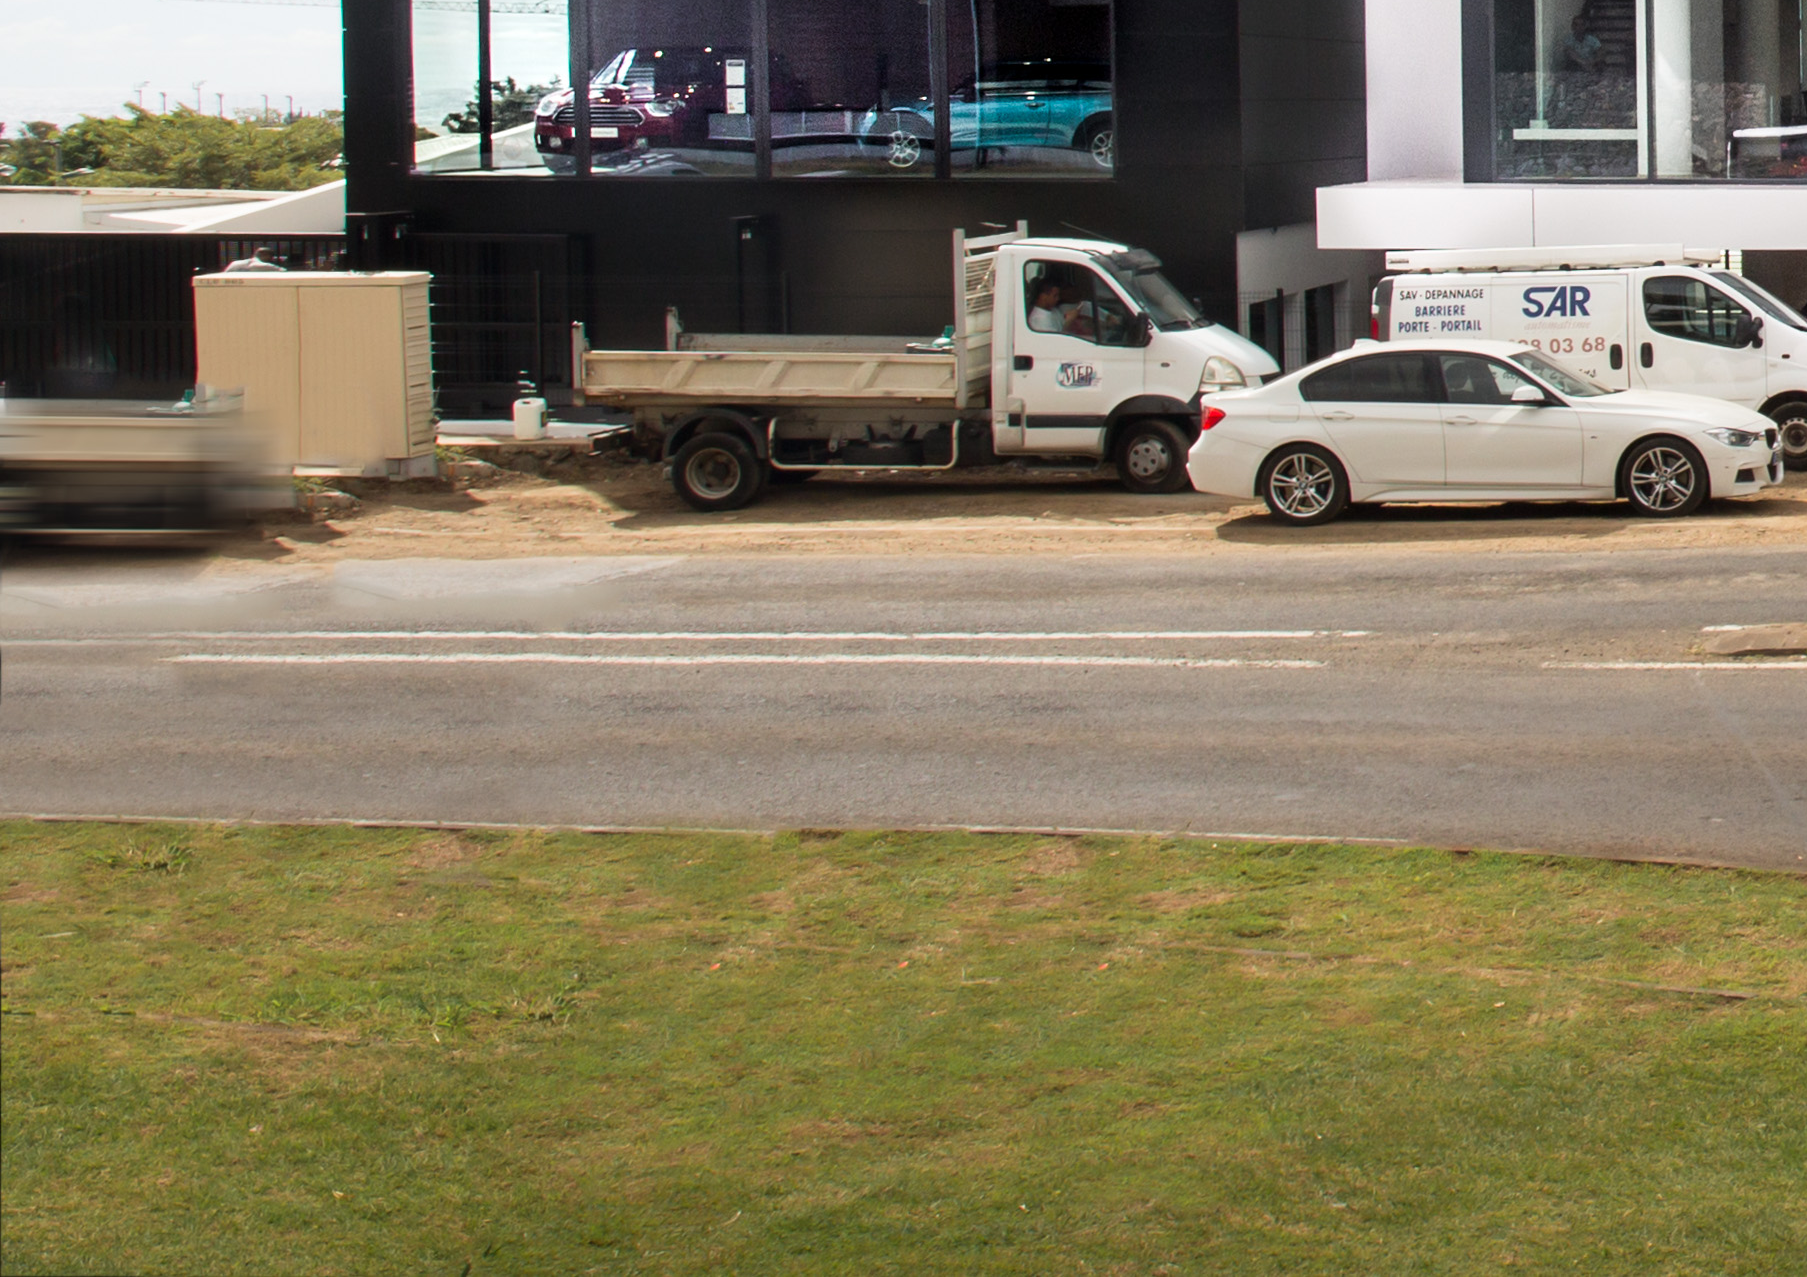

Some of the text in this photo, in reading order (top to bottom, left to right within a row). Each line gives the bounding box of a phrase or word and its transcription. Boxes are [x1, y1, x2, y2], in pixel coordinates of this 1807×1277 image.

[1399, 290, 1418, 300] SAV
[1425, 288, 1485, 300] DEPANNAGE
[1522, 285, 1591, 318] SAR
[1415, 305, 1466, 317] BARRIERE
[1398, 321, 1430, 333] PORTE
[1441, 320, 1482, 332] PORTAIL
[1549, 337, 1574, 354] 03
[1581, 336, 1606, 353] 68
